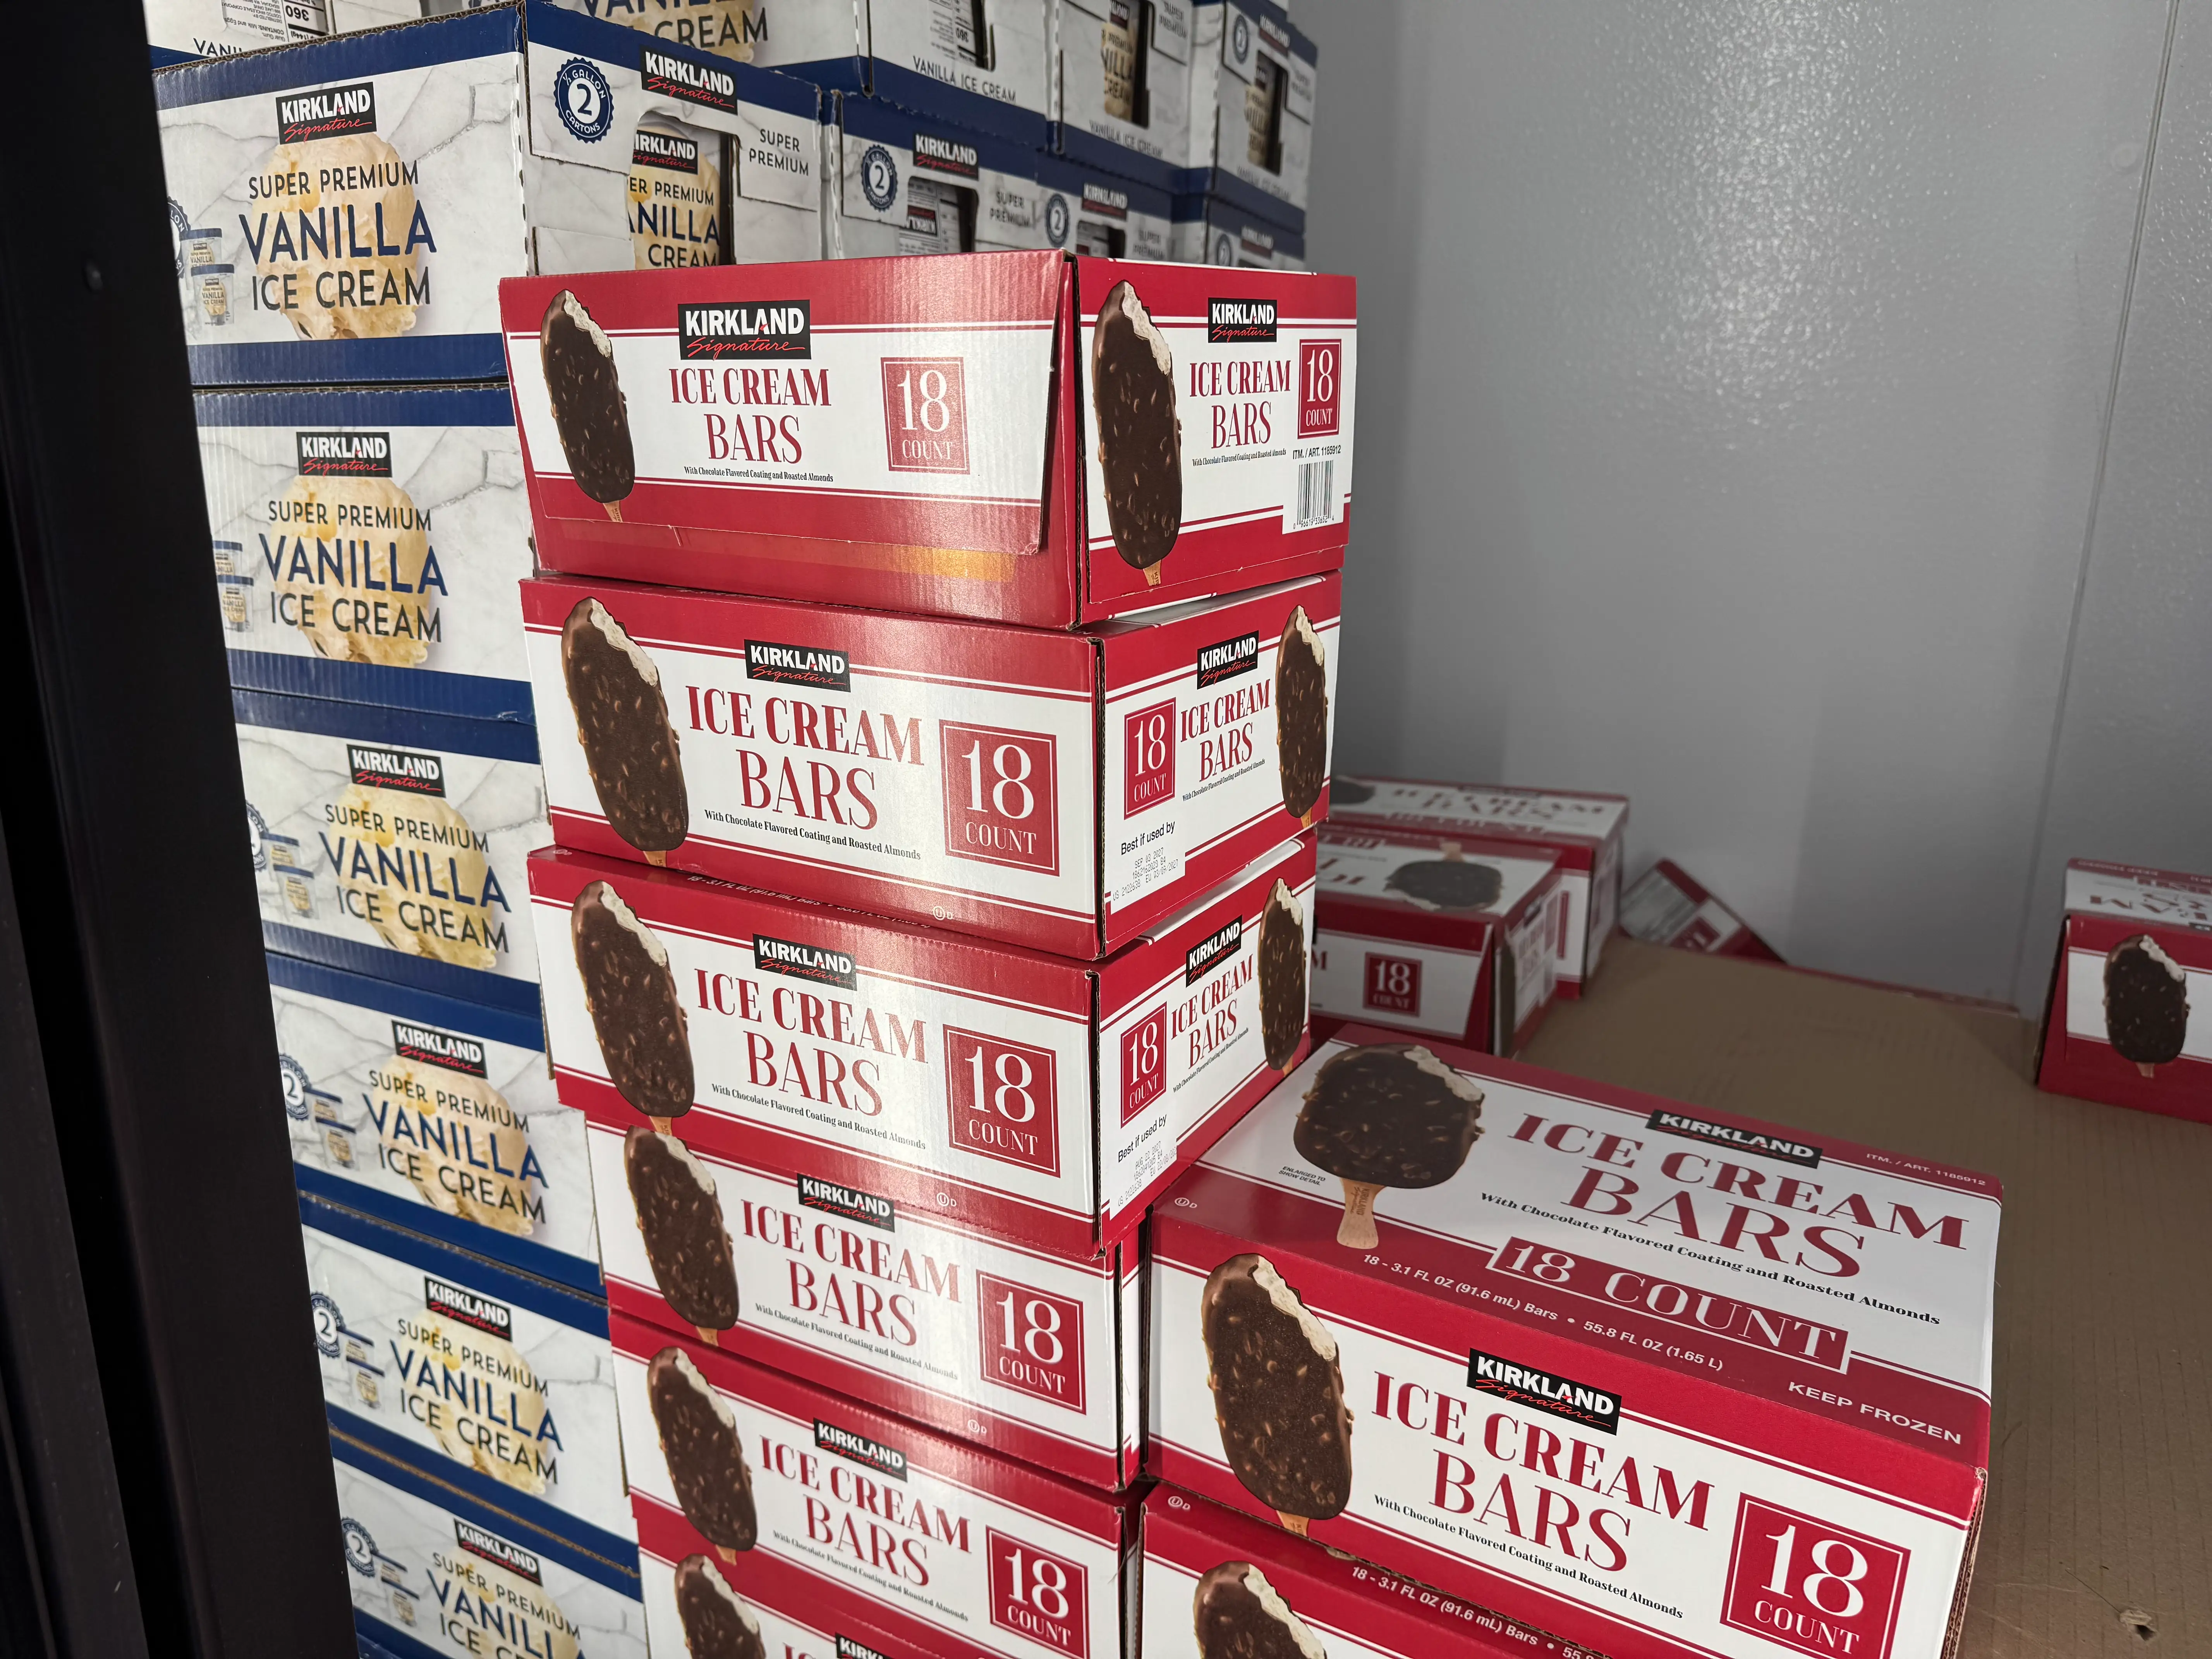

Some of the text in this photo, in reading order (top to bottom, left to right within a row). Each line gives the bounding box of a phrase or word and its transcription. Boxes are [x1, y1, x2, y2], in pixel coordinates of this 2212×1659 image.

[258, 25, 284, 35] CONTAINS:
[285, 5, 309, 21] 360
[572, 68, 606, 100] GALLON
[646, 51, 734, 96] KIRKLAND
[647, 77, 735, 108] Signature
[913, 56, 1016, 102] VANILLA ICE CREAM
[281, 89, 371, 125] KIRKLAND
[576, 83, 593, 115] 2
[284, 118, 372, 144] Signature
[565, 110, 600, 133] CARTONS
[760, 129, 800, 153] SUPER
[749, 151, 809, 177] PREMIUM
[915, 134, 977, 165] KIRKLAND
[249, 160, 418, 199] SUPER PREMIUM
[655, 181, 714, 206] PREMIUM
[875, 165, 884, 189] 2
[239, 200, 437, 264] VANILLA
[252, 267, 431, 311] ICE CREAM
[685, 308, 804, 336] KIRKLAND
[1212, 304, 1274, 324] KIRKLAND
[1212, 325, 1274, 343] Signature
[687, 337, 805, 361] Signature
[669, 368, 831, 406] ICE CREAM
[1190, 360, 1291, 397] ICE CREAM
[1307, 349, 1333, 402] 18
[897, 369, 950, 433] 18
[1306, 409, 1332, 427] COUNT
[704, 414, 802, 464] BARS
[1211, 401, 1271, 449] BARS
[302, 436, 387, 459] KIRKLAND
[303, 459, 388, 477] Signature
[902, 439, 953, 460] COUNT
[1293, 449, 1304, 459] ITM.
[1309, 447, 1320, 457] ART.
[1321, 445, 1341, 456] 1185912
[684, 466, 833, 482] With Chocolate Flavored Coating and Roasted Almonds
[268, 500, 432, 531] SUPER PREMIUM
[258, 533, 448, 596] VANILLA
[271, 592, 441, 642] ICE CREAM
[750, 645, 845, 675] KIRKLAND
[752, 665, 846, 686] Signature
[1200, 659, 1256, 686] Signature
[1201, 637, 1257, 672] KIRKLAND
[686, 685, 924, 767] ICE CREAM
[1180, 679, 1270, 743] ICE CREAM
[352, 749, 439, 780] KIRKLAND
[1134, 714, 1166, 777] 18
[1199, 722, 1254, 783] BARS
[356, 770, 441, 792] Signature
[736, 749, 878, 830] BARS
[961, 740, 1035, 820] 18
[1134, 773, 1166, 803] COUNT
[325, 804, 489, 853] SUPER PREMIUM
[965, 821, 1037, 855] COUNT
[1121, 821, 1175, 855] Best if used by
[318, 831, 512, 912] VANILLA
[336, 885, 509, 953] ICE CREAM
[759, 939, 852, 974] KIRKLAND
[761, 958, 852, 984] Signature
[1376, 960, 1410, 995] 18
[694, 968, 929, 1064] ICE CREAM
[742, 1030, 883, 1117] BARS
[963, 1046, 1036, 1123] 18
[969, 1118, 1038, 1157] COUNT
[1118, 1114, 1167, 1163] Best if used by
[1659, 1113, 1816, 1161] KIRKLAND
[1279, 1170, 1321, 1185] SHOW DETAIL
[1283, 1166, 1316, 1178] ENLARGED
[1508, 1112, 1970, 1250] ICE CREAM
[1867, 1153, 1892, 1164] ITM.
[1904, 1163, 1931, 1173] ART.
[1936, 1170, 1986, 1185] 1185912
[1561, 1165, 1865, 1278] BARS
[1480, 1192, 1941, 1326] With Chocolate Flavored Coating and Roasted Almonds
[428, 1281, 509, 1326] KIRKLAND
[1364, 1254, 1380, 1266] 18
[1391, 1263, 1411, 1274] 3.1
[1413, 1270, 1430, 1281] FL
[1434, 1277, 1454, 1288] OZ
[1456, 1282, 1490, 1300] (91.6
[1492, 1295, 1520, 1310] mL)
[1523, 1303, 1558, 1321] Bars
[1583, 1321, 1616, 1338] 55.8
[1620, 1331, 1637, 1345] FL
[1642, 1338, 1663, 1352] OZ
[1666, 1346, 1705, 1364] (1.65
[1708, 1358, 1723, 1371] L)
[1505, 1244, 1838, 1360] 18 COUNT
[398, 1319, 548, 1396] SUPER PREMIUM
[390, 1339, 564, 1452] VANILLA
[1476, 1356, 1615, 1416] KIRKLAND
[1476, 1378, 1613, 1429] Signature
[1788, 1381, 1962, 1444] KEEP FROZEN
[400, 1388, 558, 1484] ICE CREAM
[818, 1423, 904, 1469] KIRKLAND
[1372, 1371, 1716, 1532] ICE CREAM
[759, 1434, 972, 1554] ICE CREAM
[1429, 1448, 1632, 1573] BARS
[803, 1494, 930, 1587] BARS
[1005, 1548, 1069, 1620] 18
[1760, 1523, 1869, 1619] 18
[1008, 1605, 1072, 1647] COUNT
[1753, 1598, 1860, 1657] COUNT
